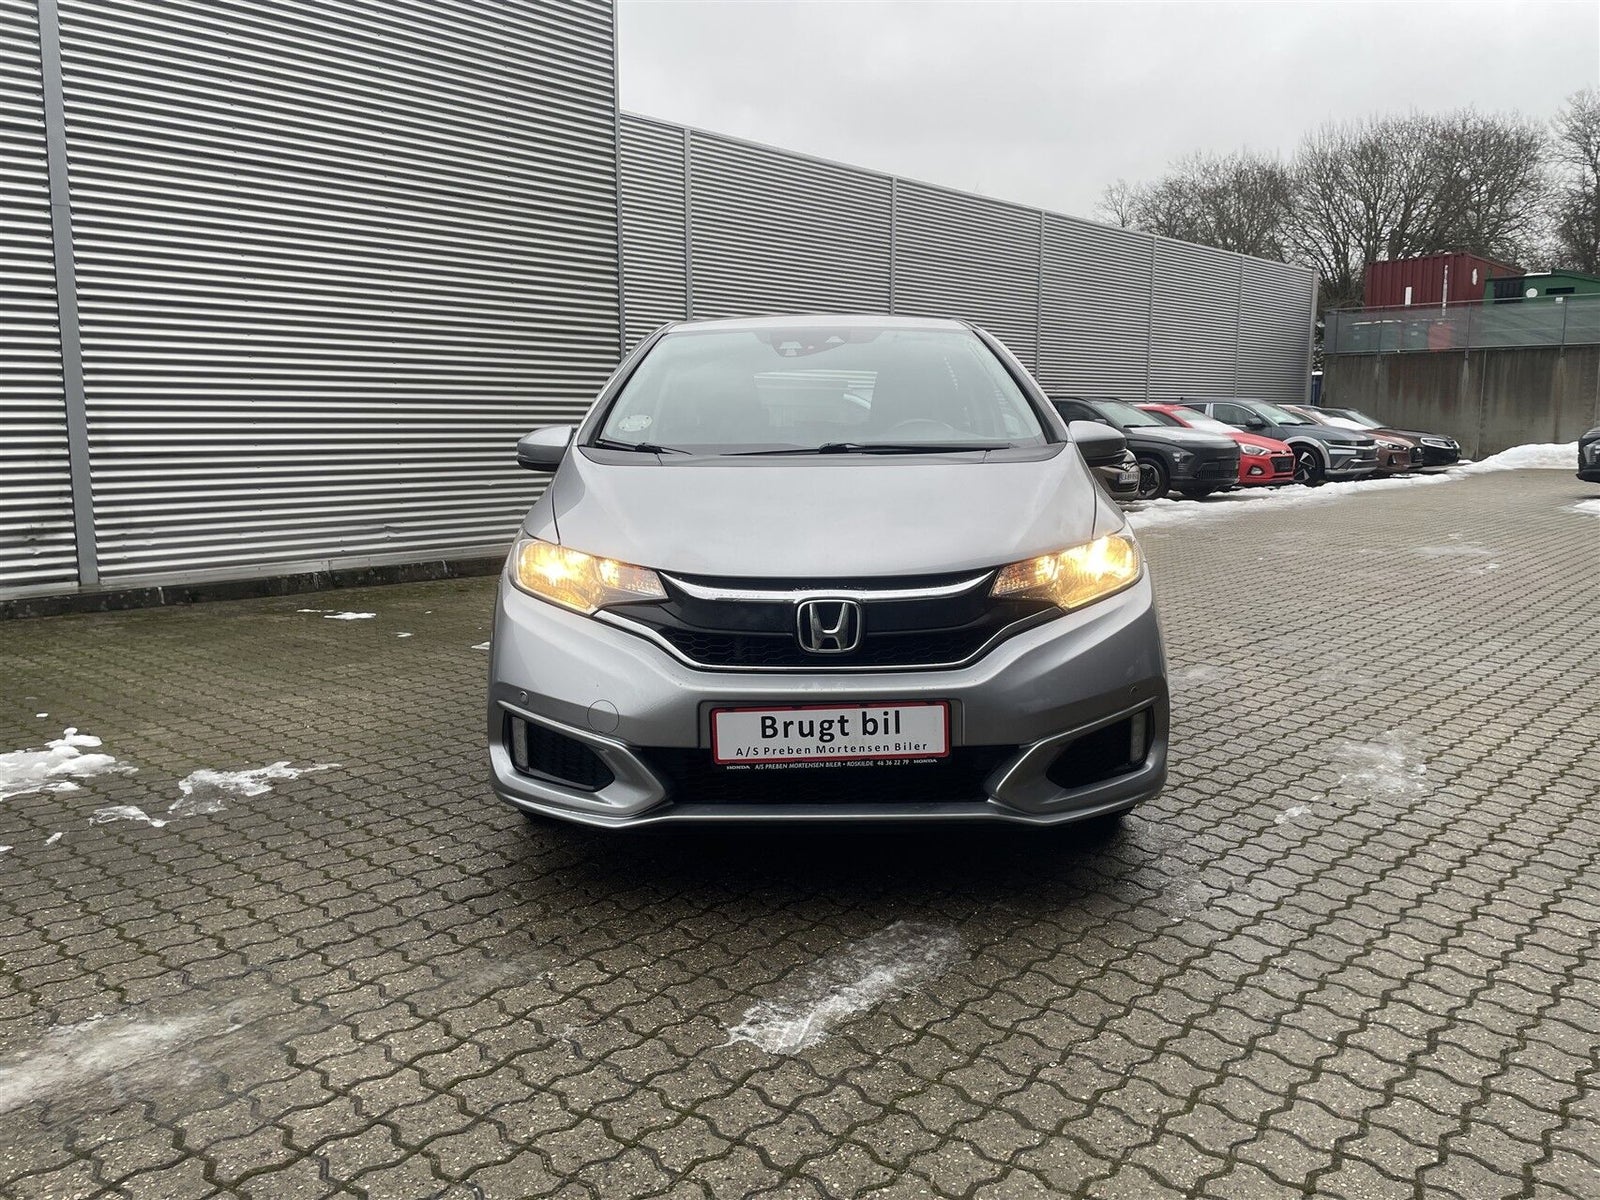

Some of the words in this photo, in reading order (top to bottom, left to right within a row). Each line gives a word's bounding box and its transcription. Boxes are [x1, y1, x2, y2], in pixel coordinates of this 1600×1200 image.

[760, 714, 850, 743] Brugt
[861, 710, 901, 736] bil
[735, 746, 759, 757] A/S
[763, 745, 811, 756] Preben
[816, 743, 890, 754] Mortensen
[894, 741, 927, 751] Biler
[789, 761, 824, 769] MORTENSEN
